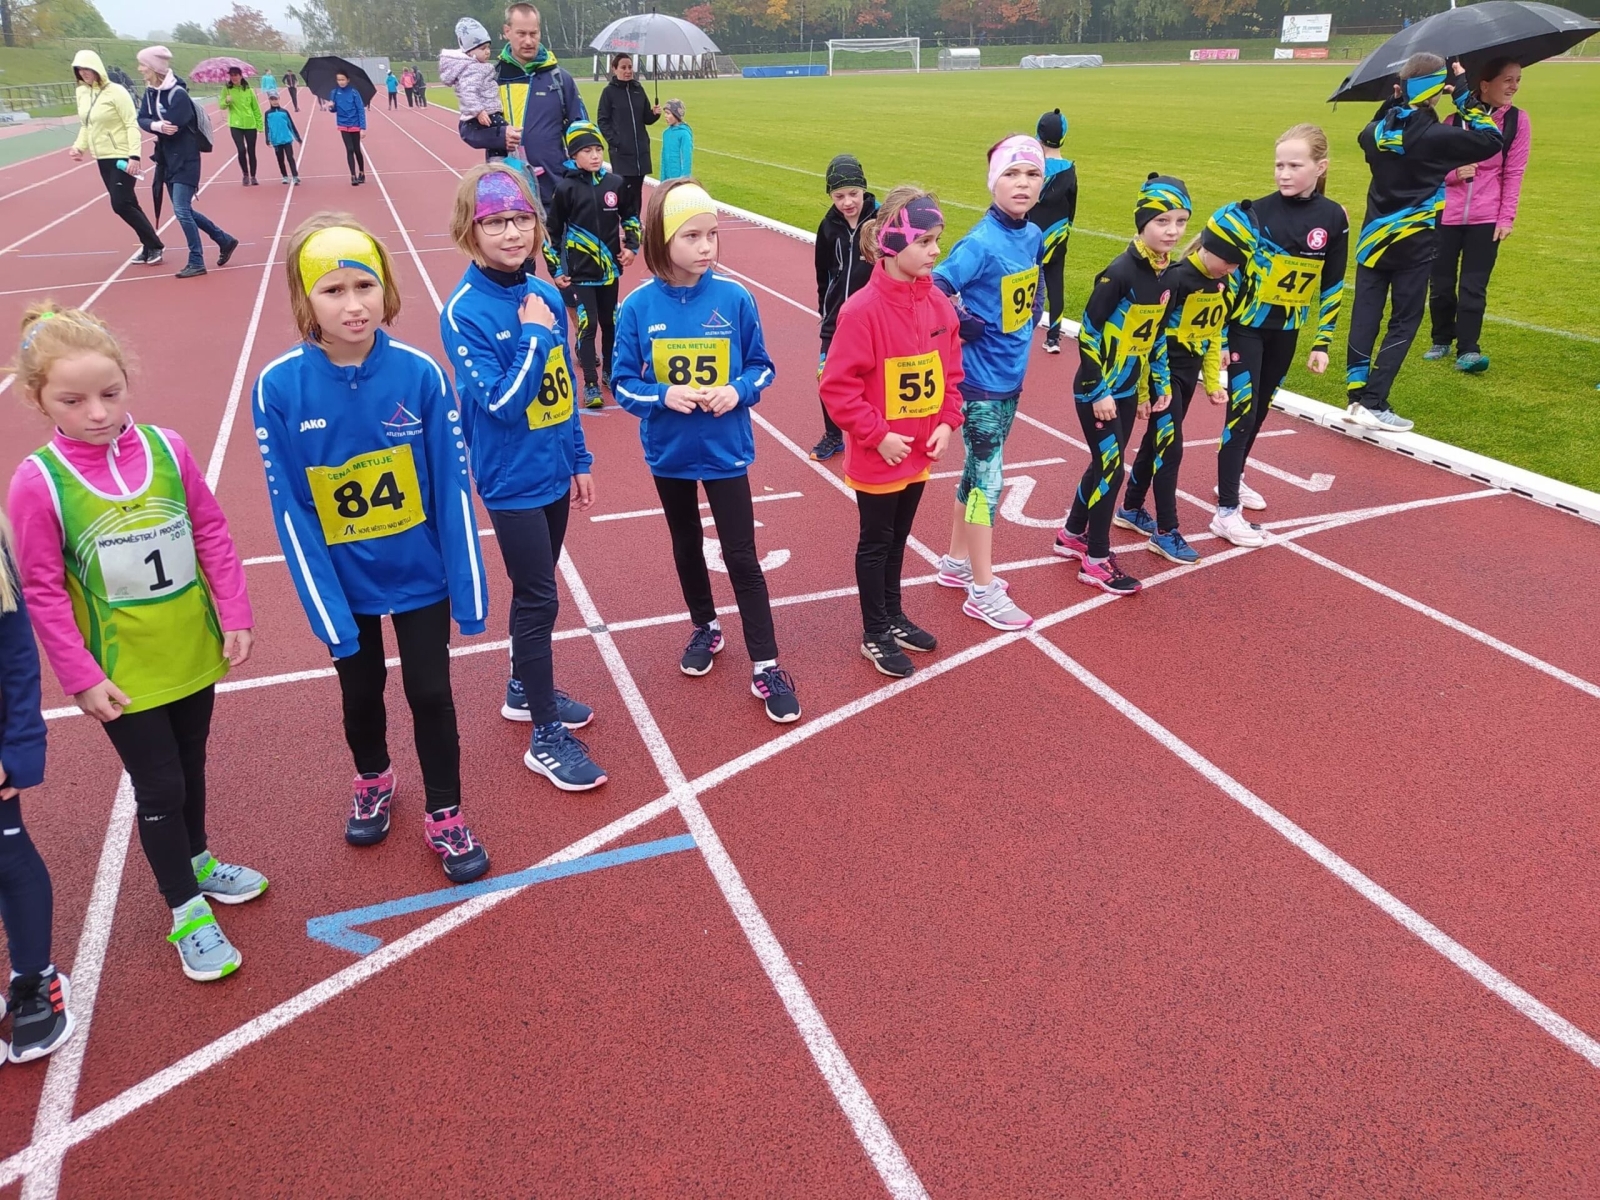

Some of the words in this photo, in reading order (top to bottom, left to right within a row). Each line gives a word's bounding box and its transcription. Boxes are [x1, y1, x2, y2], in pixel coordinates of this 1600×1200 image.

[1277, 270, 1317, 294] 47
[1013, 282, 1036, 314] 93
[648, 323, 667, 334] JAKO
[1132, 318, 1160, 342] 4
[1191, 304, 1223, 329] 40
[668, 355, 718, 386] 85
[537, 366, 569, 407] 86
[898, 368, 936, 402] 55
[299, 418, 327, 433] JAKO
[327, 467, 351, 480] CENA
[352, 455, 393, 471] METUJE
[333, 470, 406, 519] 84
[144, 548, 174, 592] 1
